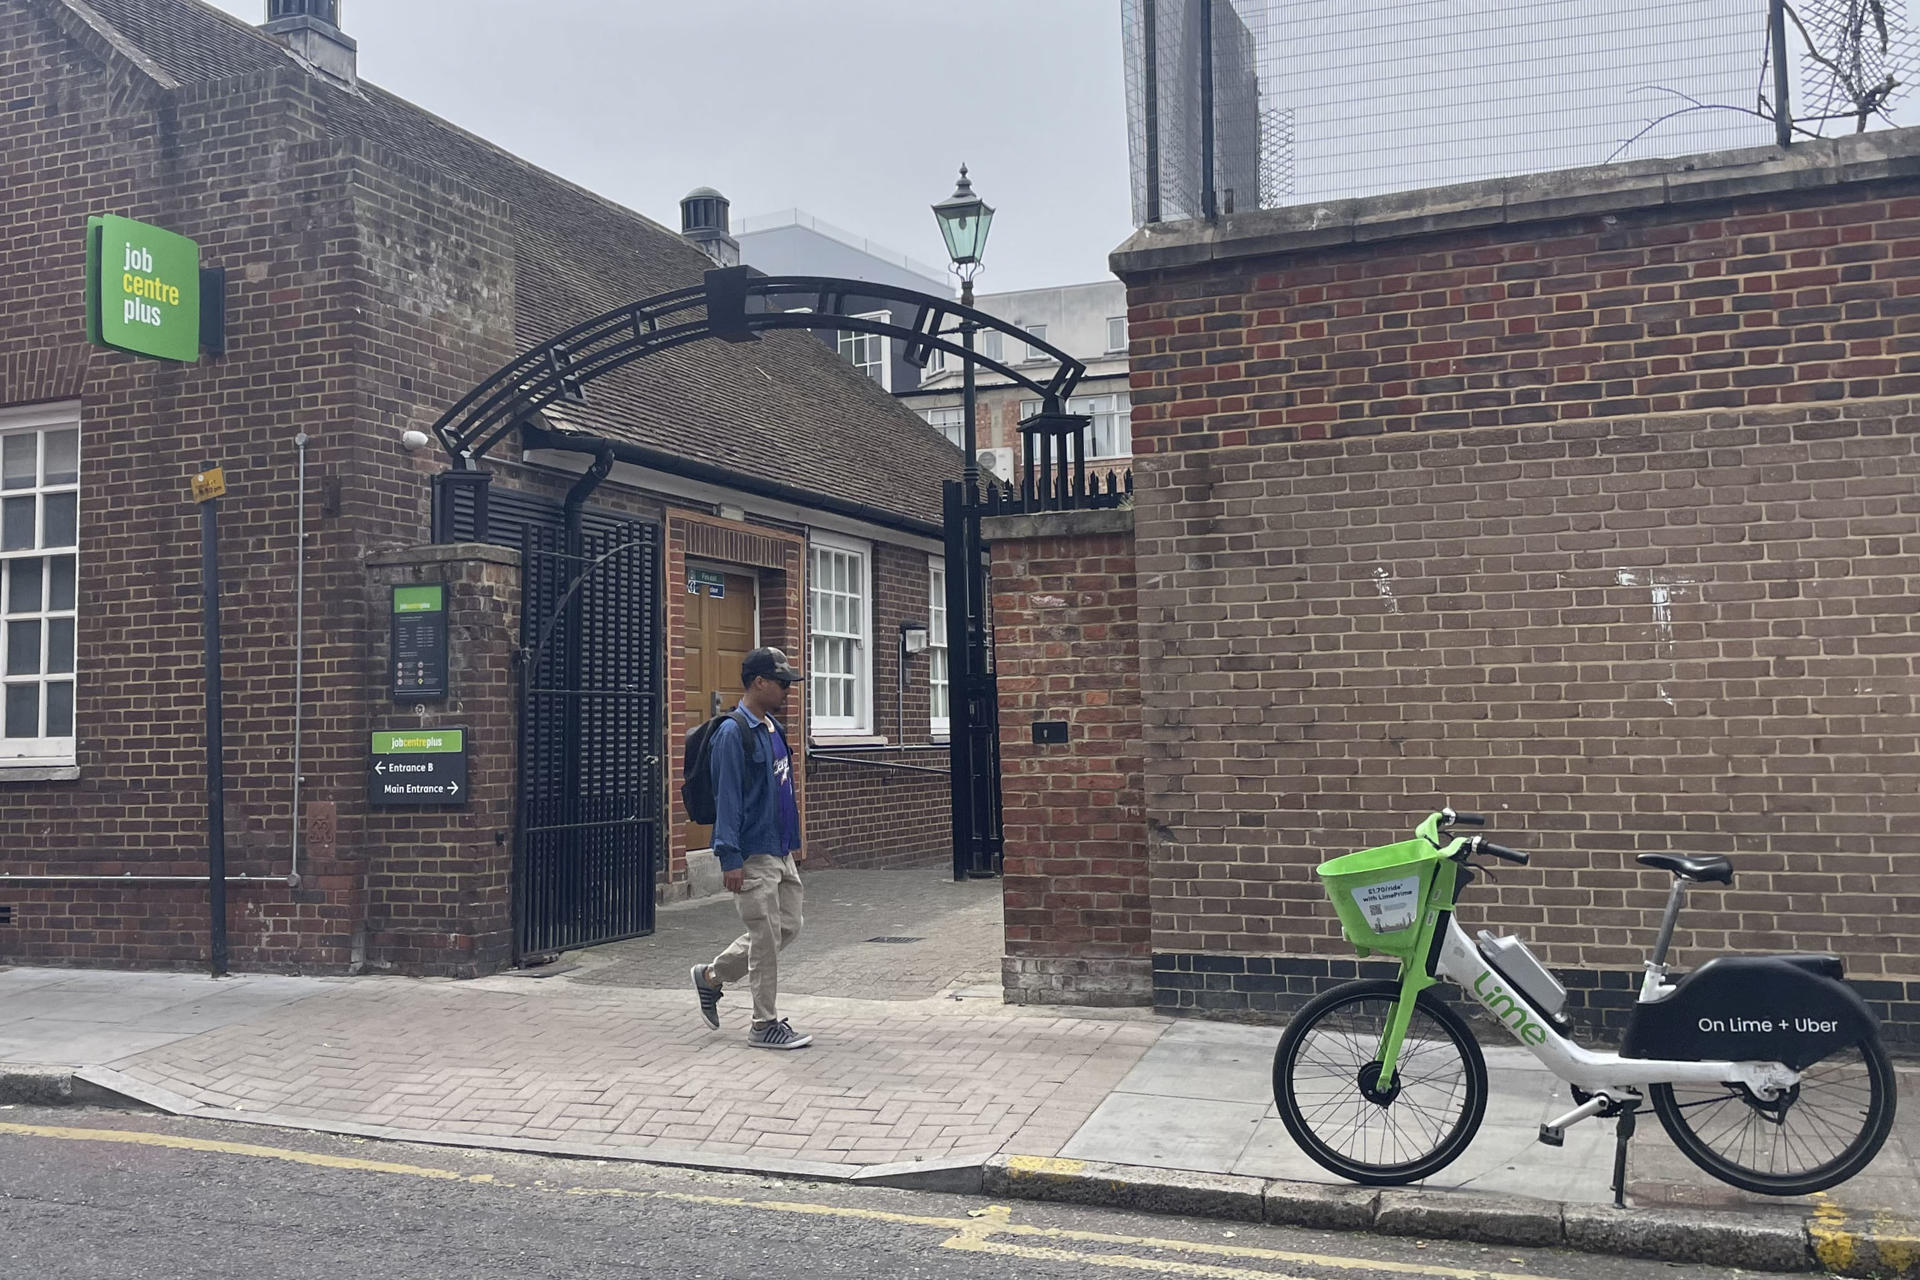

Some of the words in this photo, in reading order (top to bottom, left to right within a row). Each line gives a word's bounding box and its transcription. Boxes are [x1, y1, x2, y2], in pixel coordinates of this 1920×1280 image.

[123, 242, 153, 273] job
[122, 273, 180, 306] centre
[124, 297, 161, 326] plus
[391, 737, 442, 749] jobcentreplus
[388, 763, 426, 772] Entrance
[428, 763, 434, 772] B
[384, 784, 404, 793] Main
[406, 784, 444, 793] Entrance
[1379, 890, 1413, 901] LimePrime
[1474, 970, 1546, 1046] Lime
[1698, 1018, 1725, 1032] On
[1729, 1017, 1773, 1032] Lime
[1795, 1018, 1838, 1032] Uber
